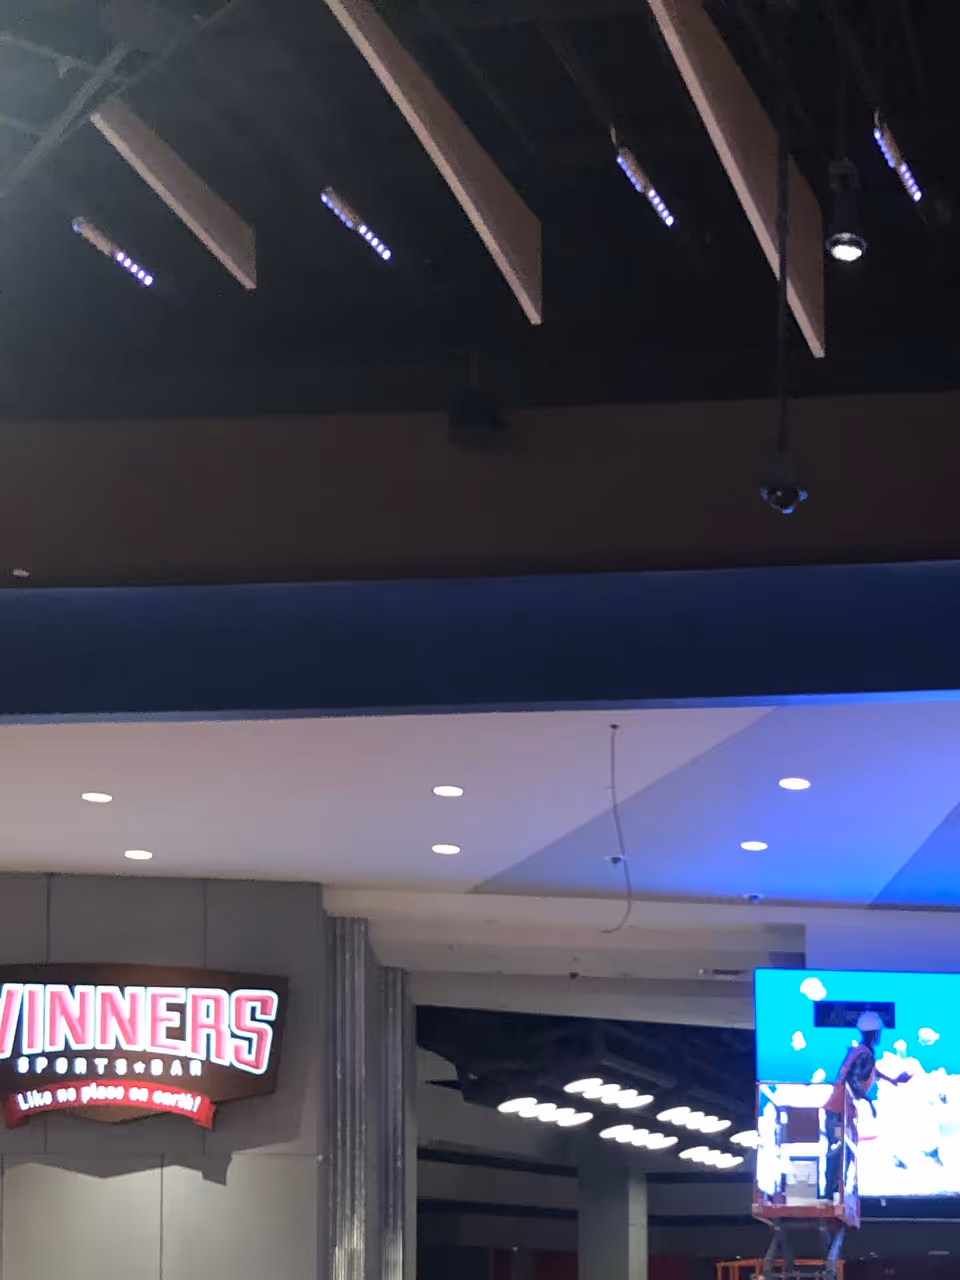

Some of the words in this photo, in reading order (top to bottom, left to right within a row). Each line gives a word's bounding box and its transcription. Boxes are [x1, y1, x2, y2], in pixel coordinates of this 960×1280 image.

[15, 1056, 128, 1076] SPORTS
[151, 1058, 203, 1077] BAR
[17, 1088, 53, 1111] Like
[56, 1086, 77, 1102] no
[81, 1082, 124, 1103] place
[129, 1087, 149, 1102] on
[152, 1089, 202, 1113] earth!
